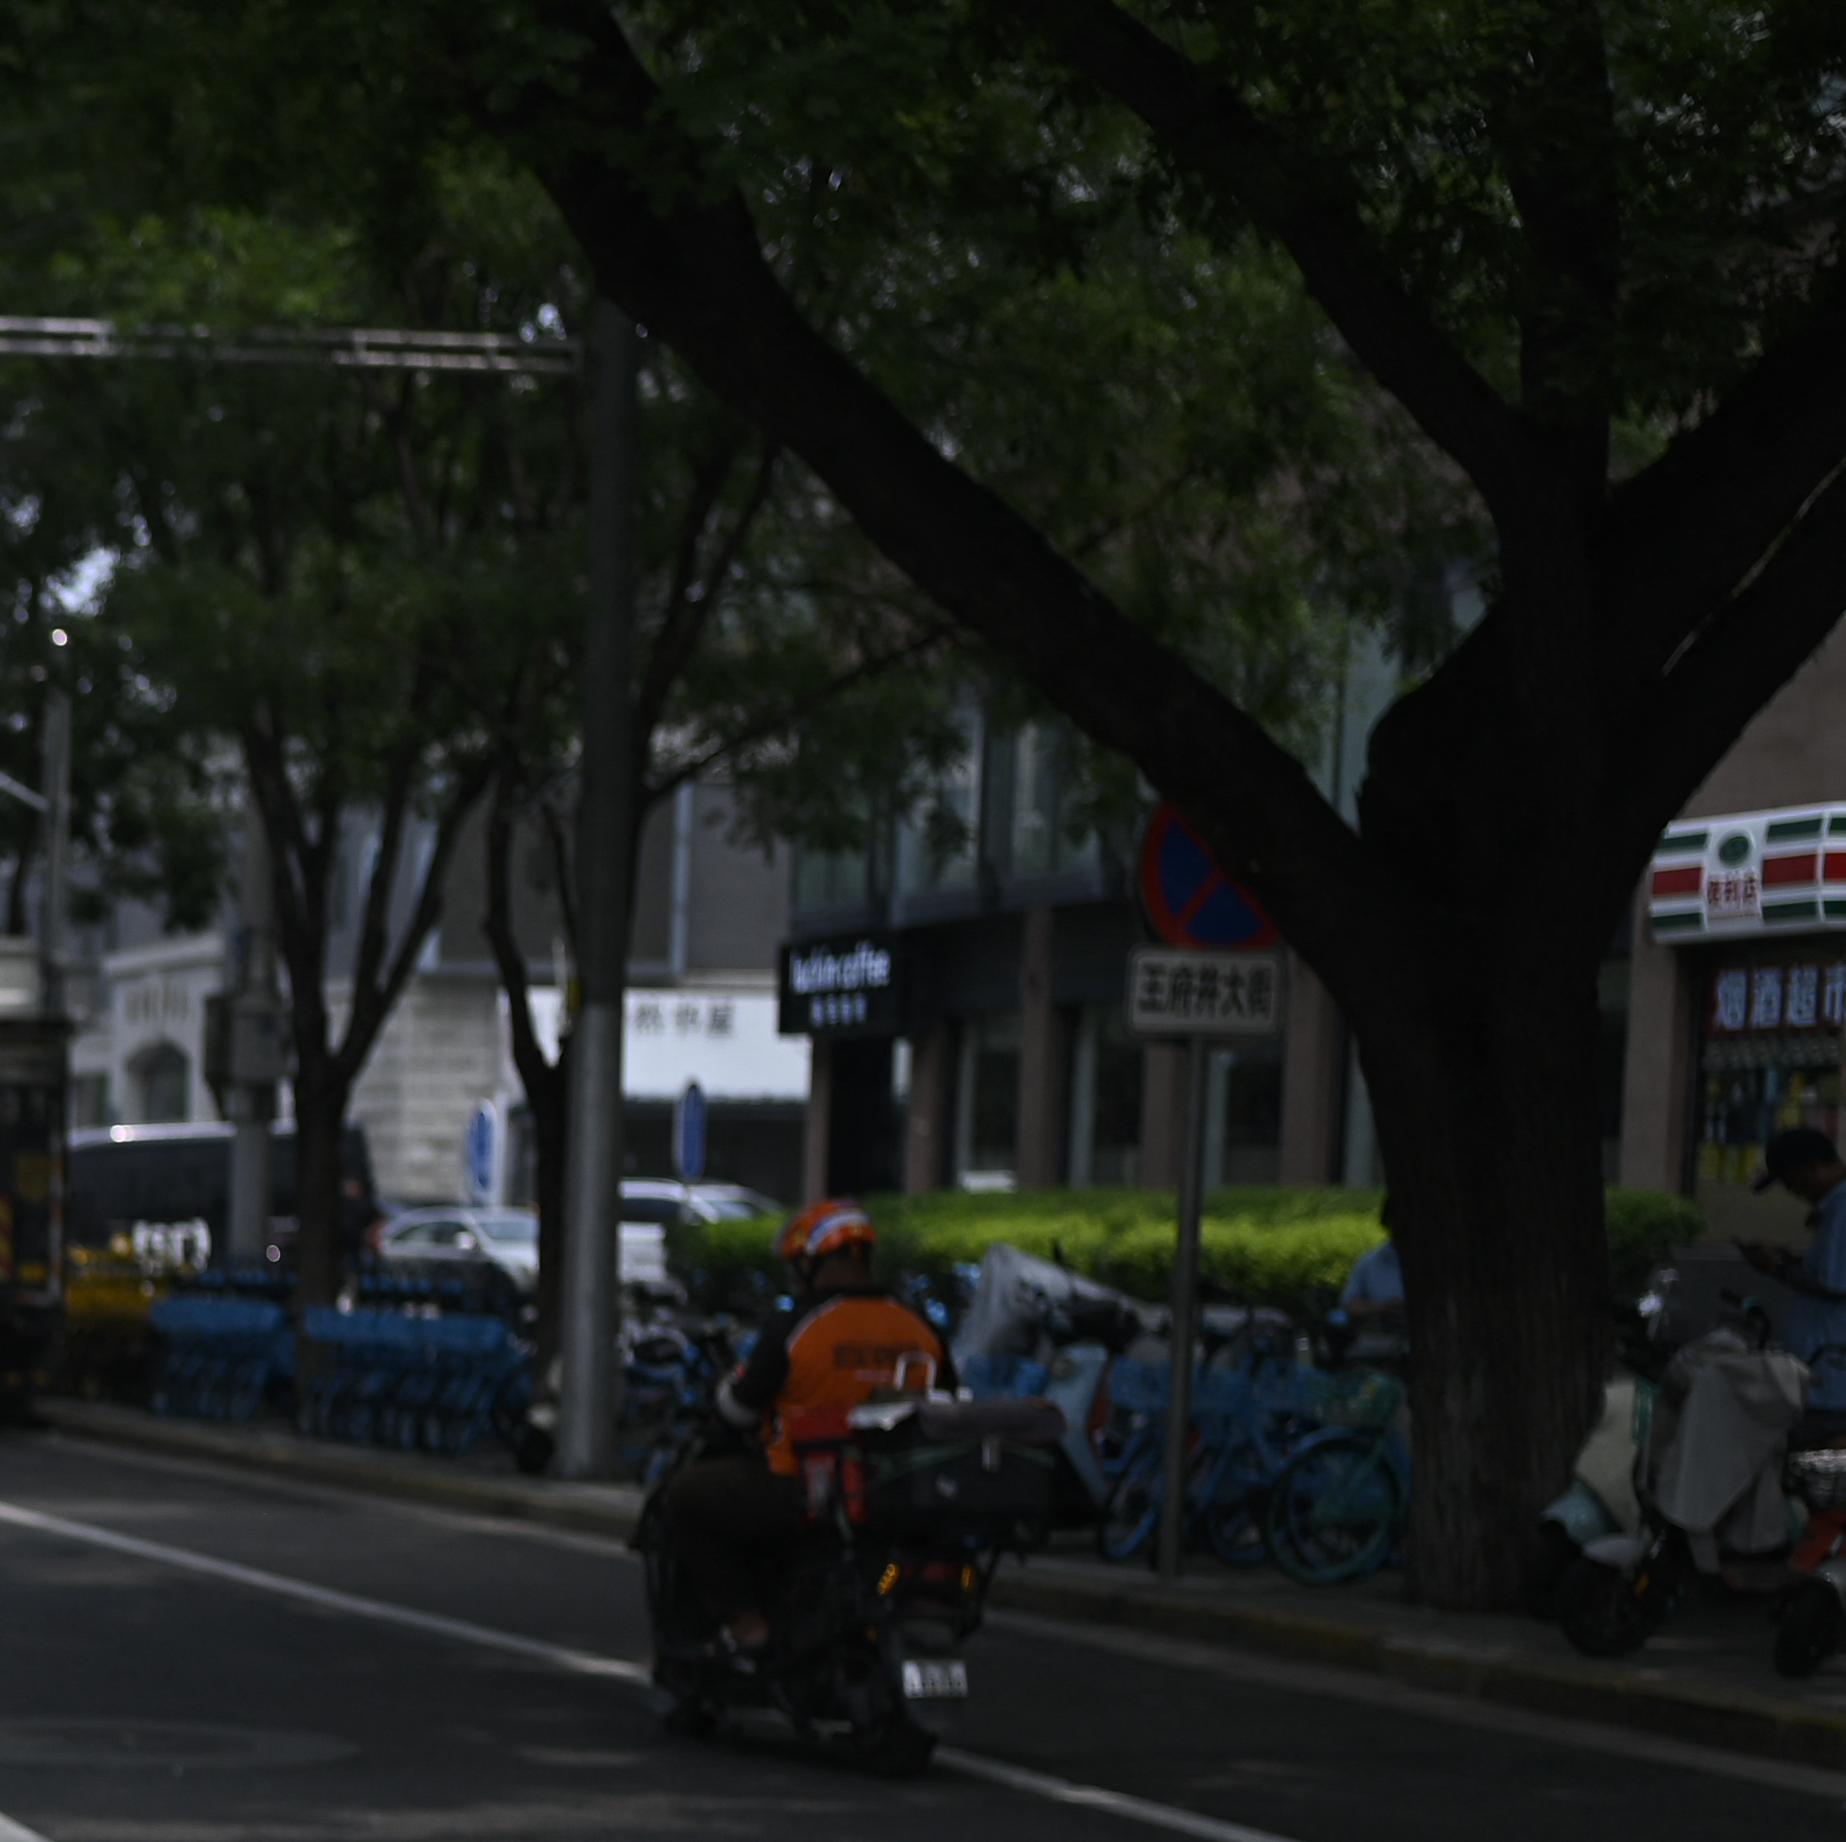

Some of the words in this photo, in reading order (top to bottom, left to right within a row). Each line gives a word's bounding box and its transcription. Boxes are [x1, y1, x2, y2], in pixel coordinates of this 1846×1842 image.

[1138, 963, 1273, 1018] 王府井大街
